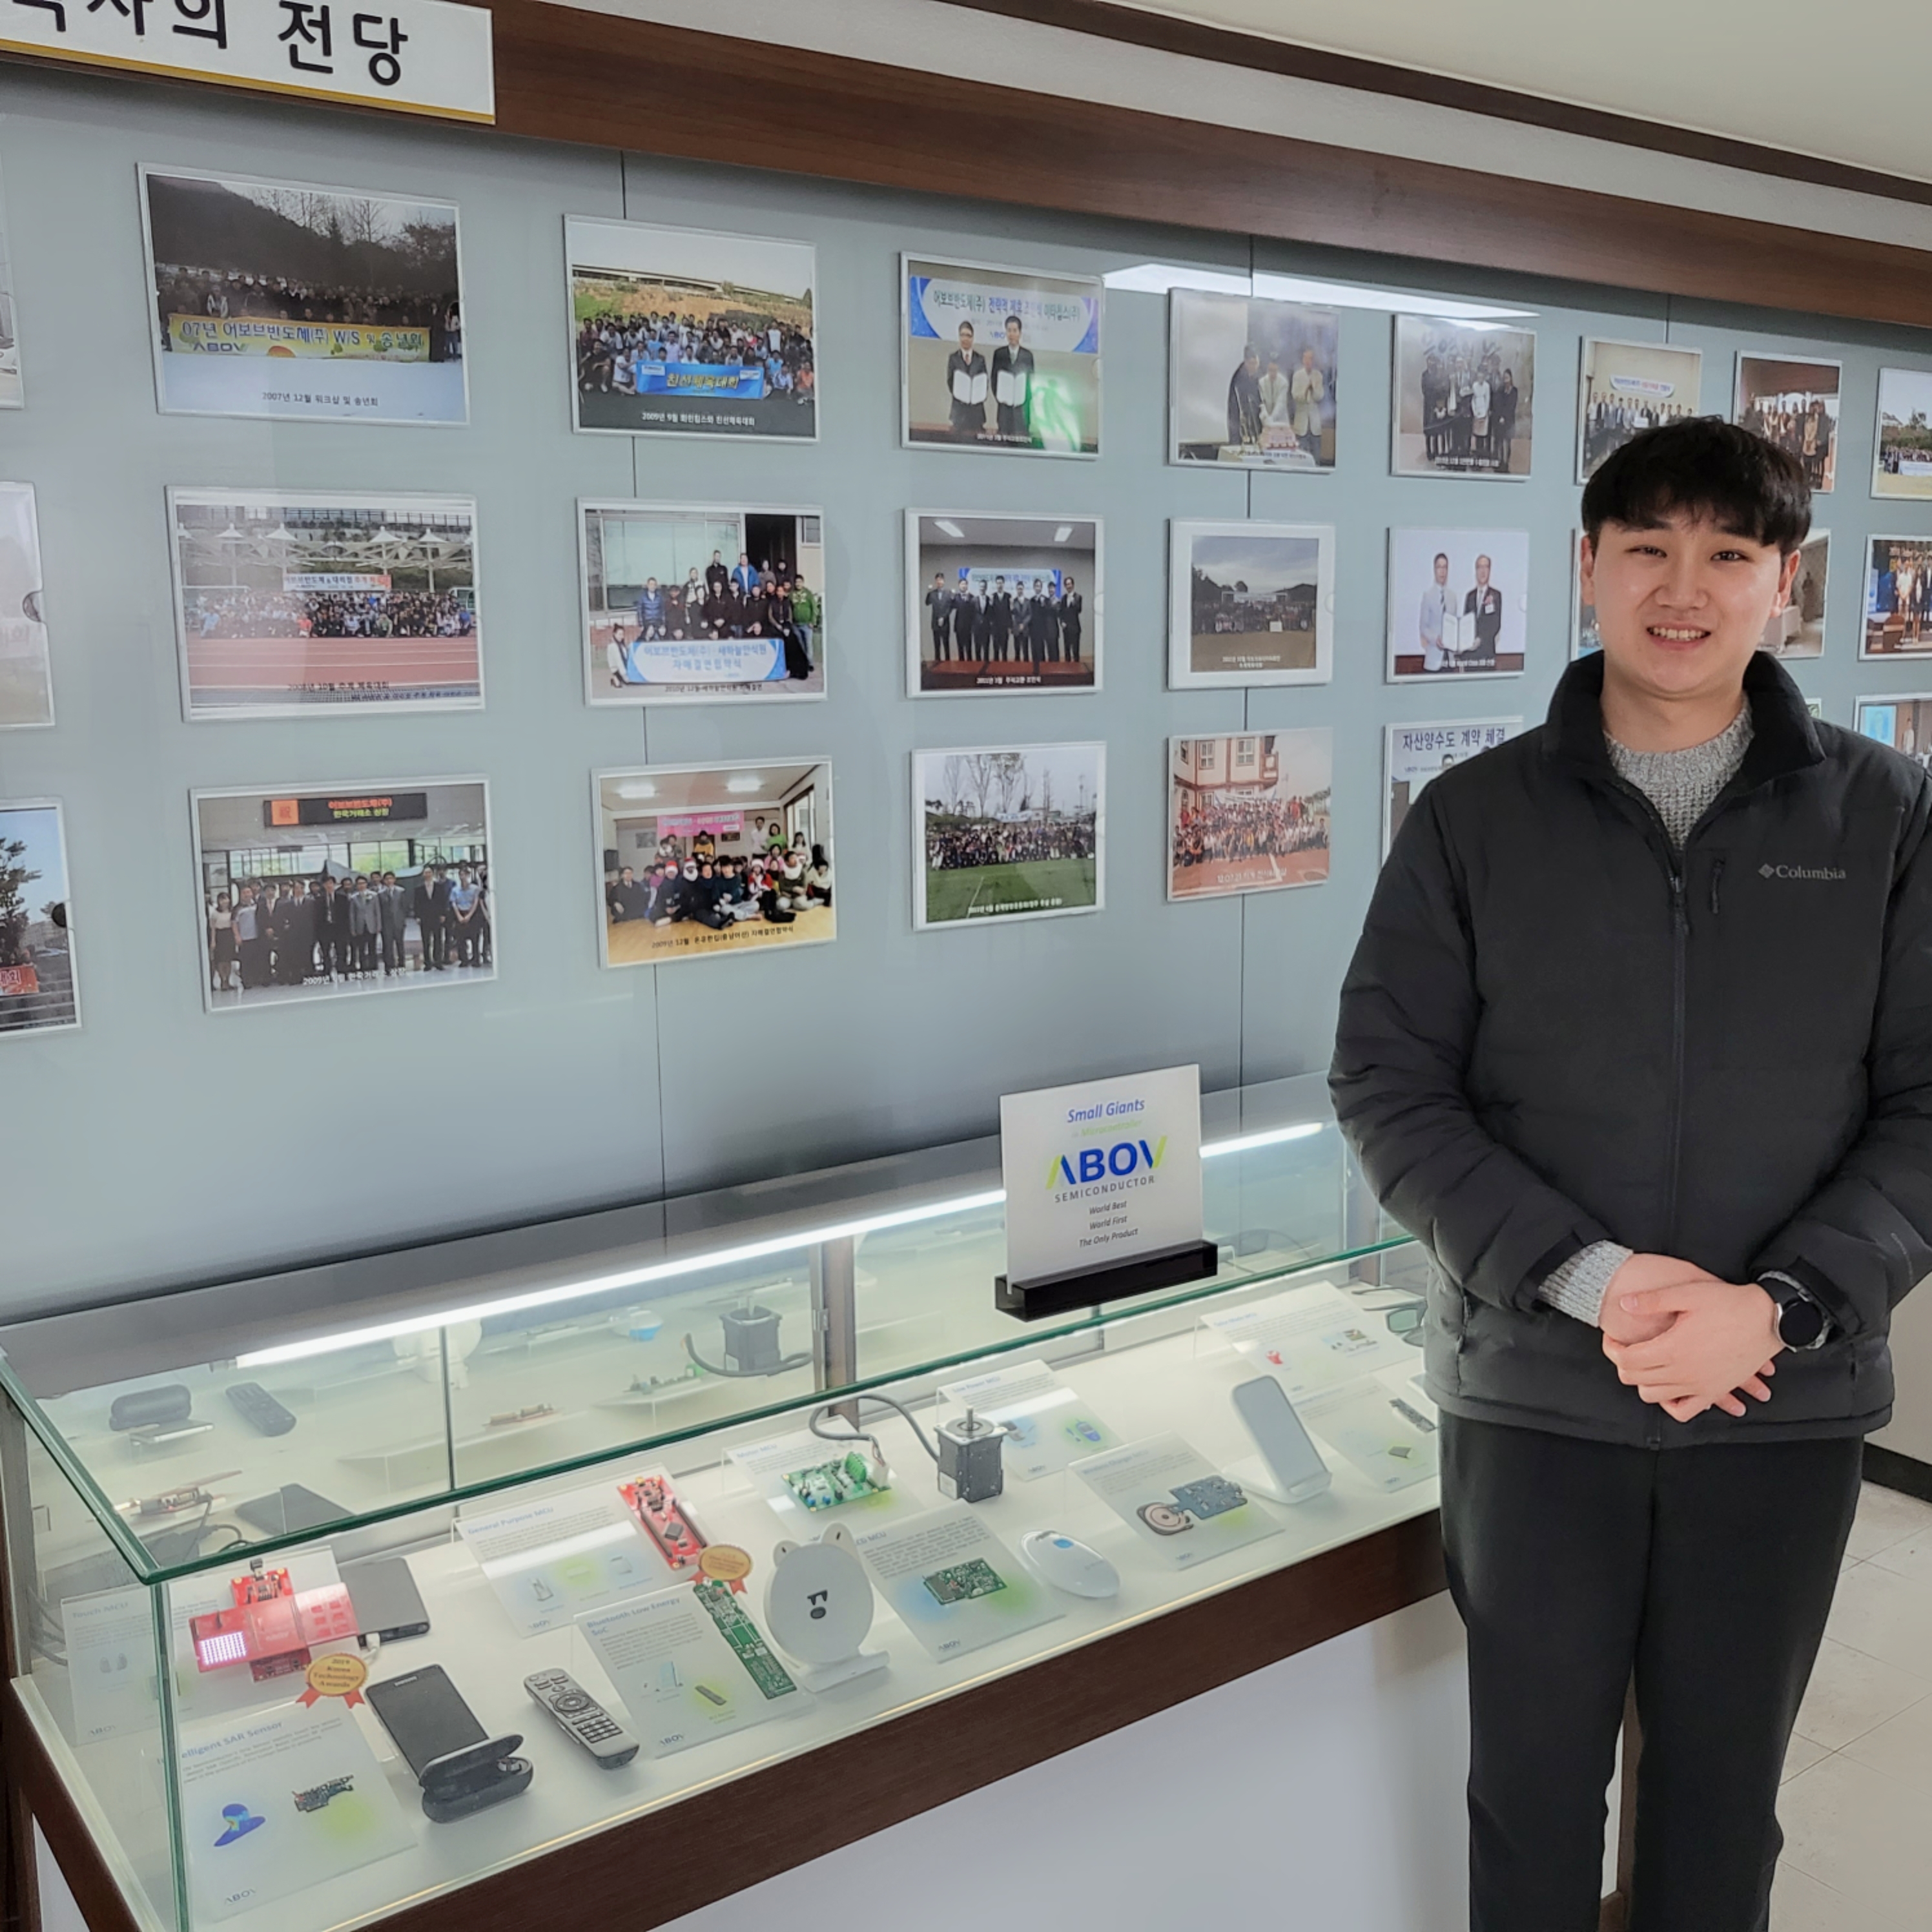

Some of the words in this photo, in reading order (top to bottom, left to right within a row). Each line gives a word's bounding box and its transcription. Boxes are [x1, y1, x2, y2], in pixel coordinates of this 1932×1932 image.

[277, 0, 408, 86] 전당
[182, 321, 218, 338] 07년
[223, 322, 328, 344] 어보브반도체(주)
[333, 329, 360, 345] W/S
[262, 392, 291, 402] 2007년
[293, 393, 312, 404] 12월
[342, 396, 351, 406] 및
[354, 397, 379, 407] 송년회
[1402, 731, 1456, 752] 자산양수도
[1461, 728, 1481, 748] 계약
[1485, 727, 1506, 746] 체결
[1775, 864, 1846, 881] Columbia
[1067, 1103, 1103, 1123] Small
[1105, 1098, 1146, 1116] Giants
[1054, 1175, 1155, 1204] SEMICONDUCTOR
[1089, 1204, 1111, 1215] World
[1111, 1200, 1127, 1210] Best
[1089, 1218, 1111, 1230] World
[1111, 1215, 1128, 1226] First
[1079, 1238, 1093, 1248] The
[1093, 1233, 1110, 1245] Only
[1111, 1228, 1139, 1240] Product
[468, 1519, 500, 1534] General
[500, 1513, 534, 1526] Purpose
[533, 1506, 553, 1517] MCU
[867, 1531, 887, 1541] MCU
[72, 1608, 102, 1619] Touch
[103, 1601, 129, 1614] MCU
[586, 1611, 631, 1629] Bluetooth
[631, 1605, 650, 1615] Low
[650, 1598, 681, 1610] Energy
[591, 1627, 610, 1636] SoC
[313, 1672, 359, 1681] Technology
[223, 1732, 246, 1745] SAR
[246, 1721, 283, 1738] Sensor
